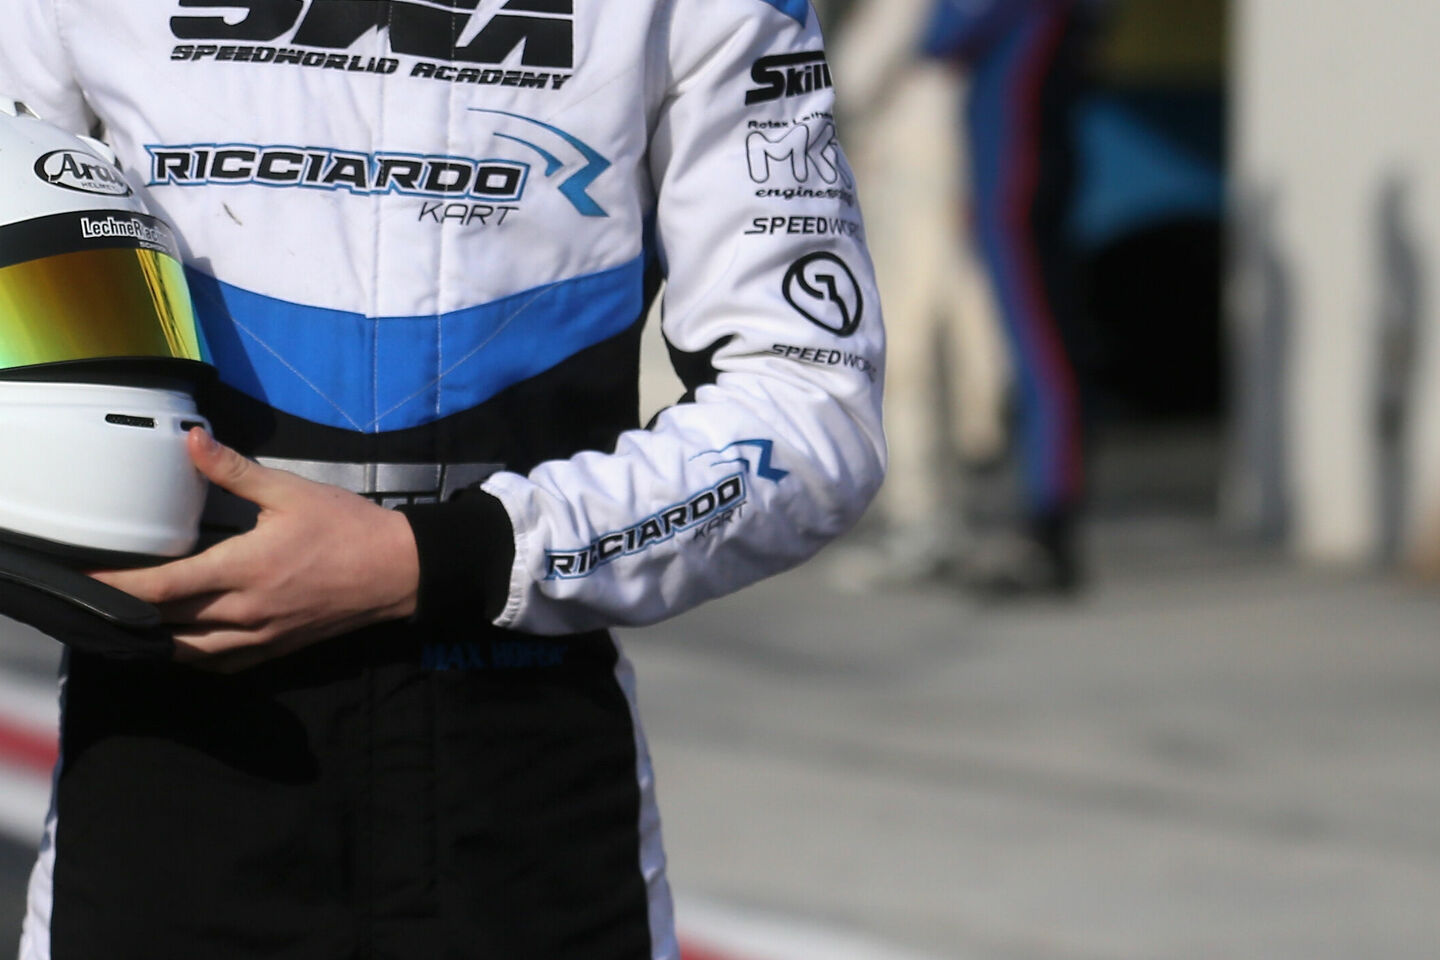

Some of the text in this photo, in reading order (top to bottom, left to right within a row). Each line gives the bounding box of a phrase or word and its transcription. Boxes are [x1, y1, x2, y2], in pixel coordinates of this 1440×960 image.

[410, 62, 573, 90] ACADEMY
[144, 143, 530, 203] RICCIARDO
[755, 186, 855, 207] engine
[418, 201, 520, 227] KART
[544, 471, 746, 580] RICCIARDO
[692, 500, 747, 541] KART
